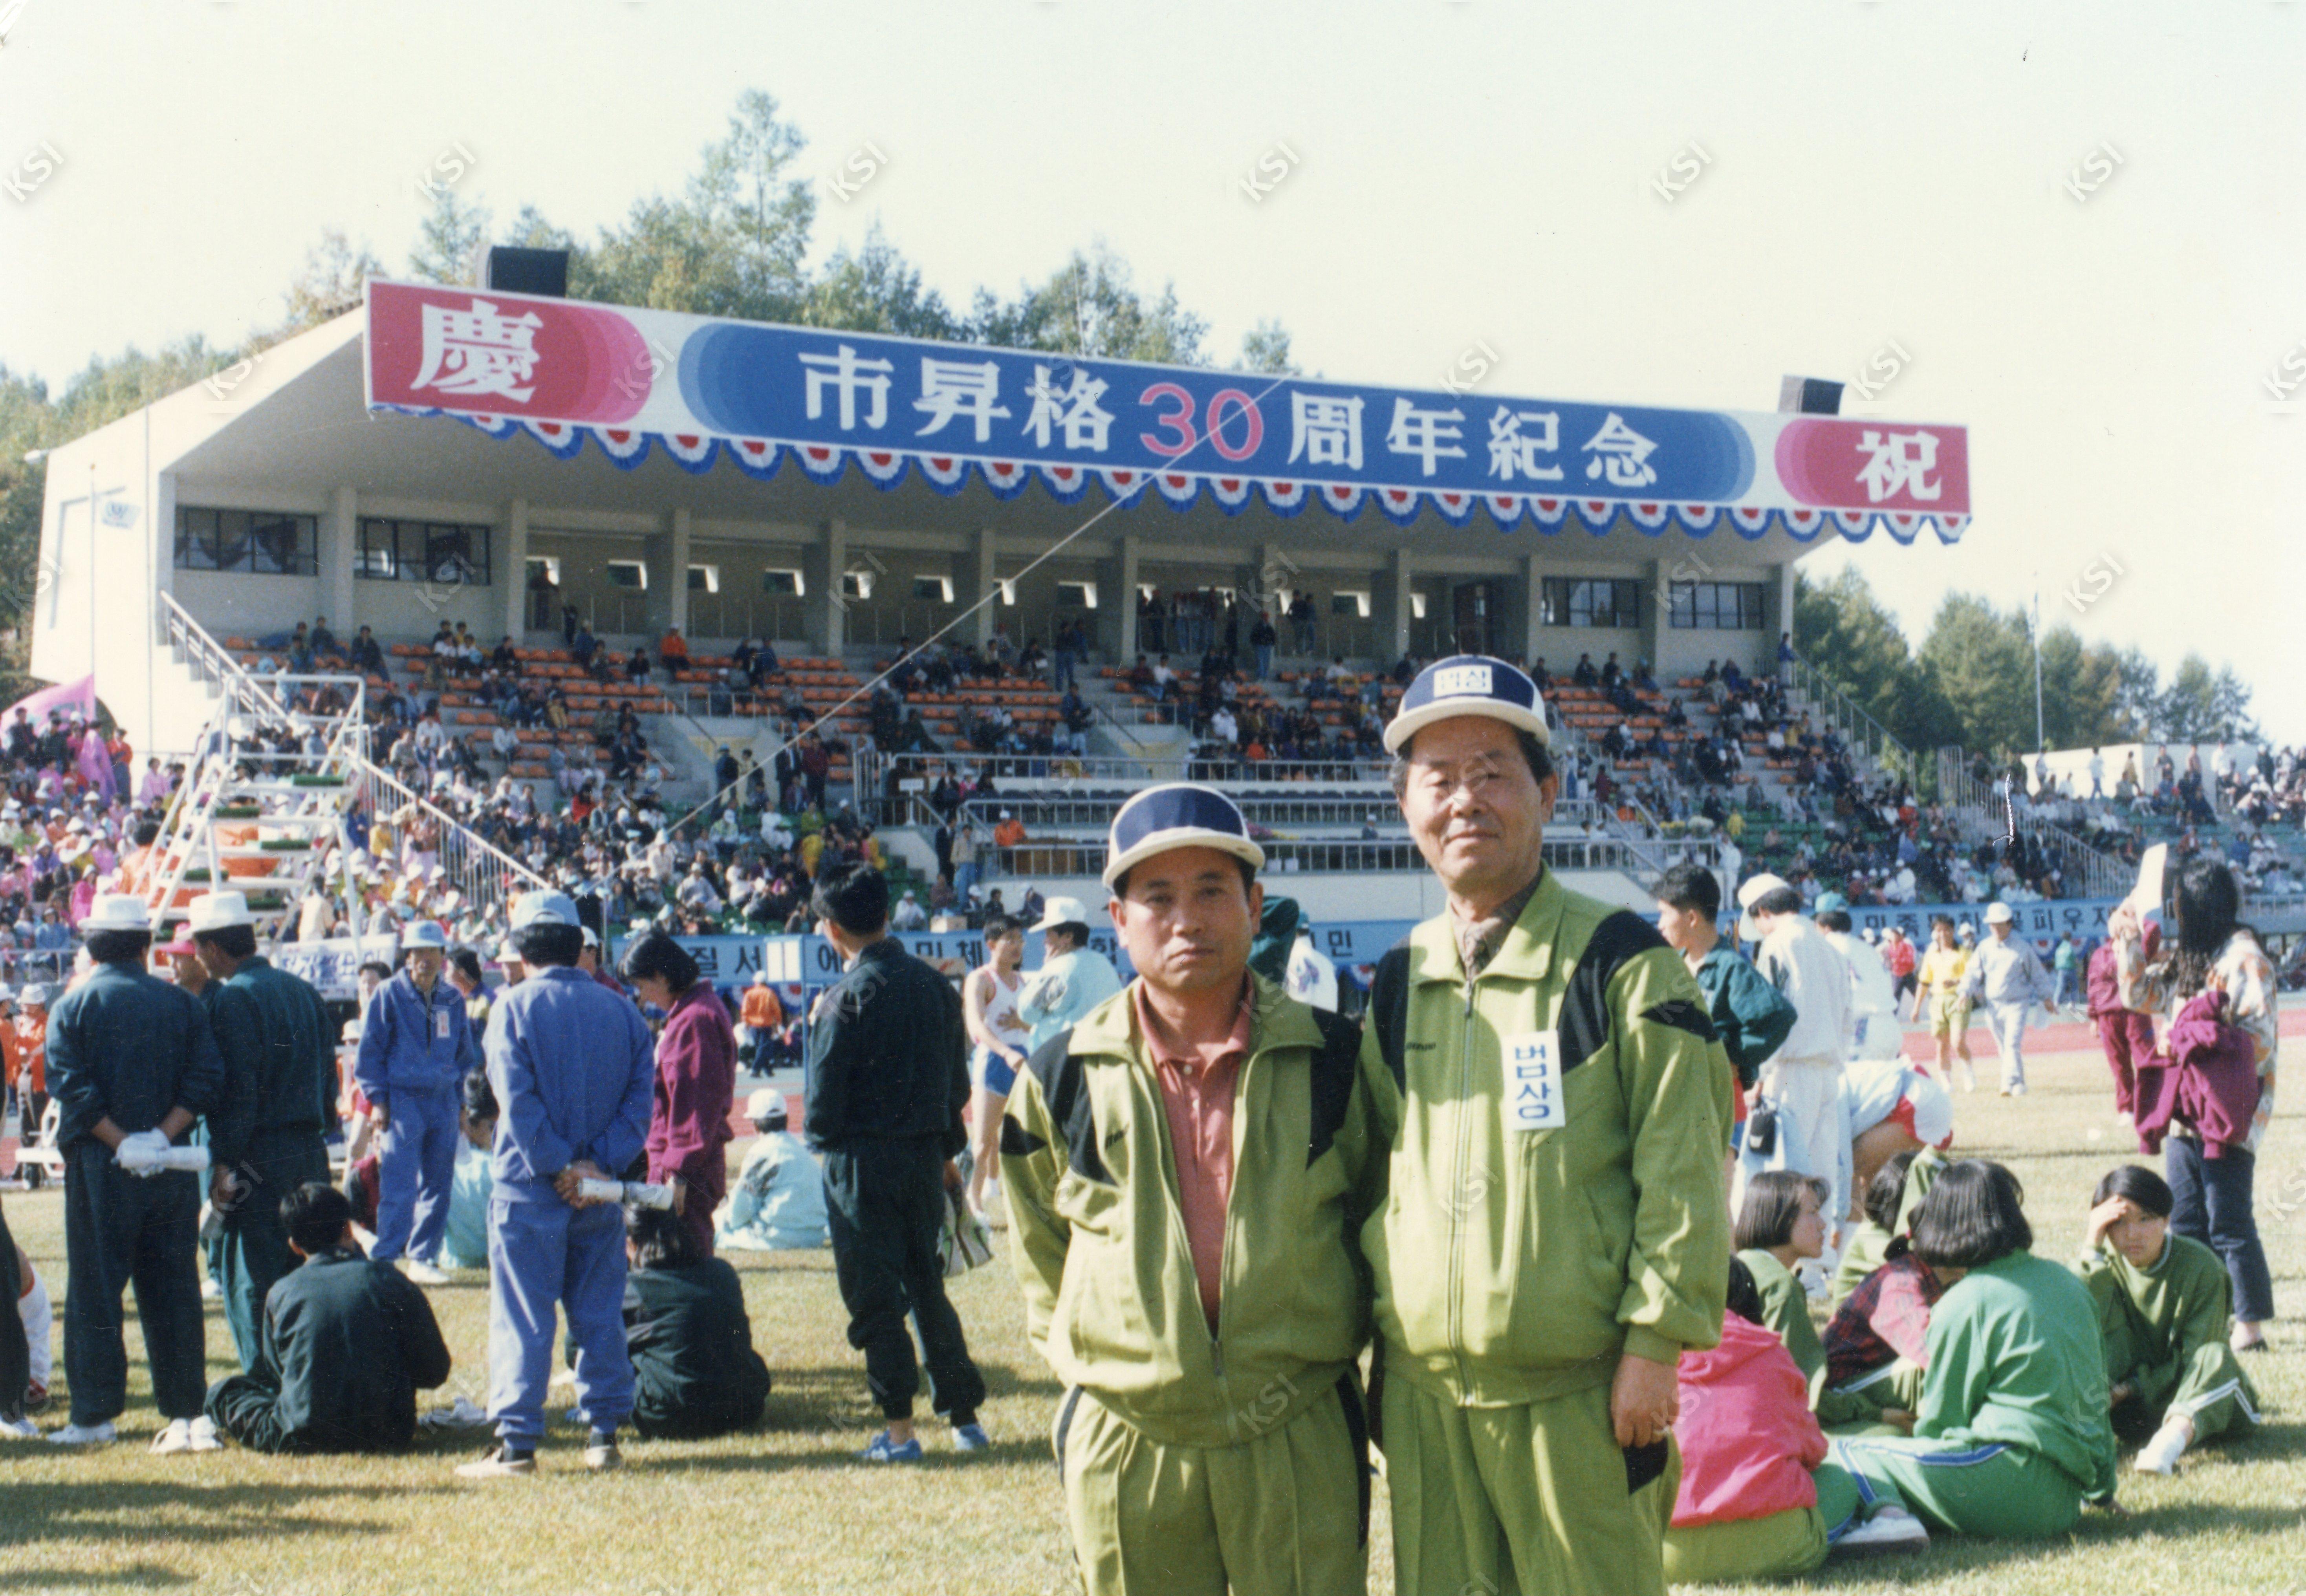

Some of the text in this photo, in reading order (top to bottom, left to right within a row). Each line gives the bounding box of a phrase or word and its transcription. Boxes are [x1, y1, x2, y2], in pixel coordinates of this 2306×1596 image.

[410, 298, 544, 404] 慶
[1856, 429, 1943, 503] 祝
[1515, 1044, 1550, 1119] 범상
